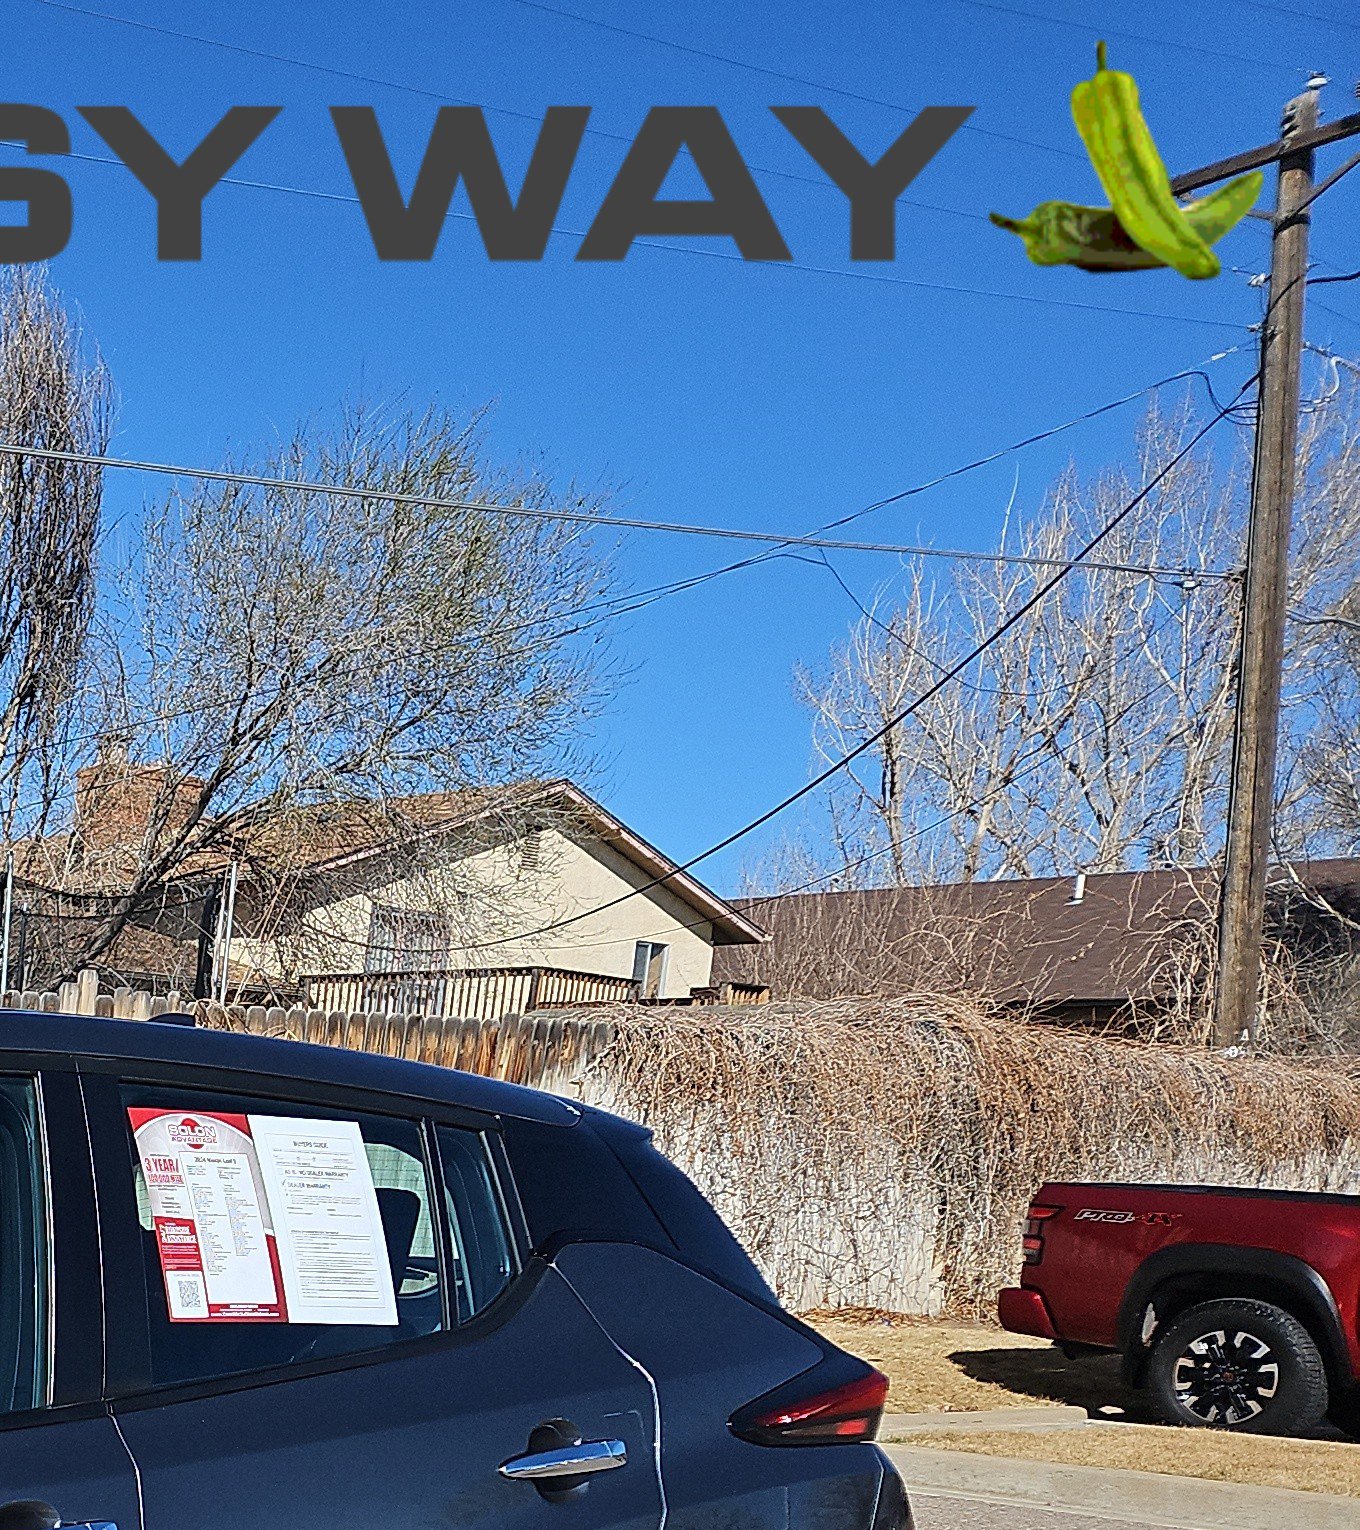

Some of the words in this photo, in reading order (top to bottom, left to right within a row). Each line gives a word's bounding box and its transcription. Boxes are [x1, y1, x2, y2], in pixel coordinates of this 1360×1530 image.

[168, 1124, 217, 1137] SOLON
[144, 1157, 152, 1172] 3
[153, 1158, 180, 1173] YEAR/
